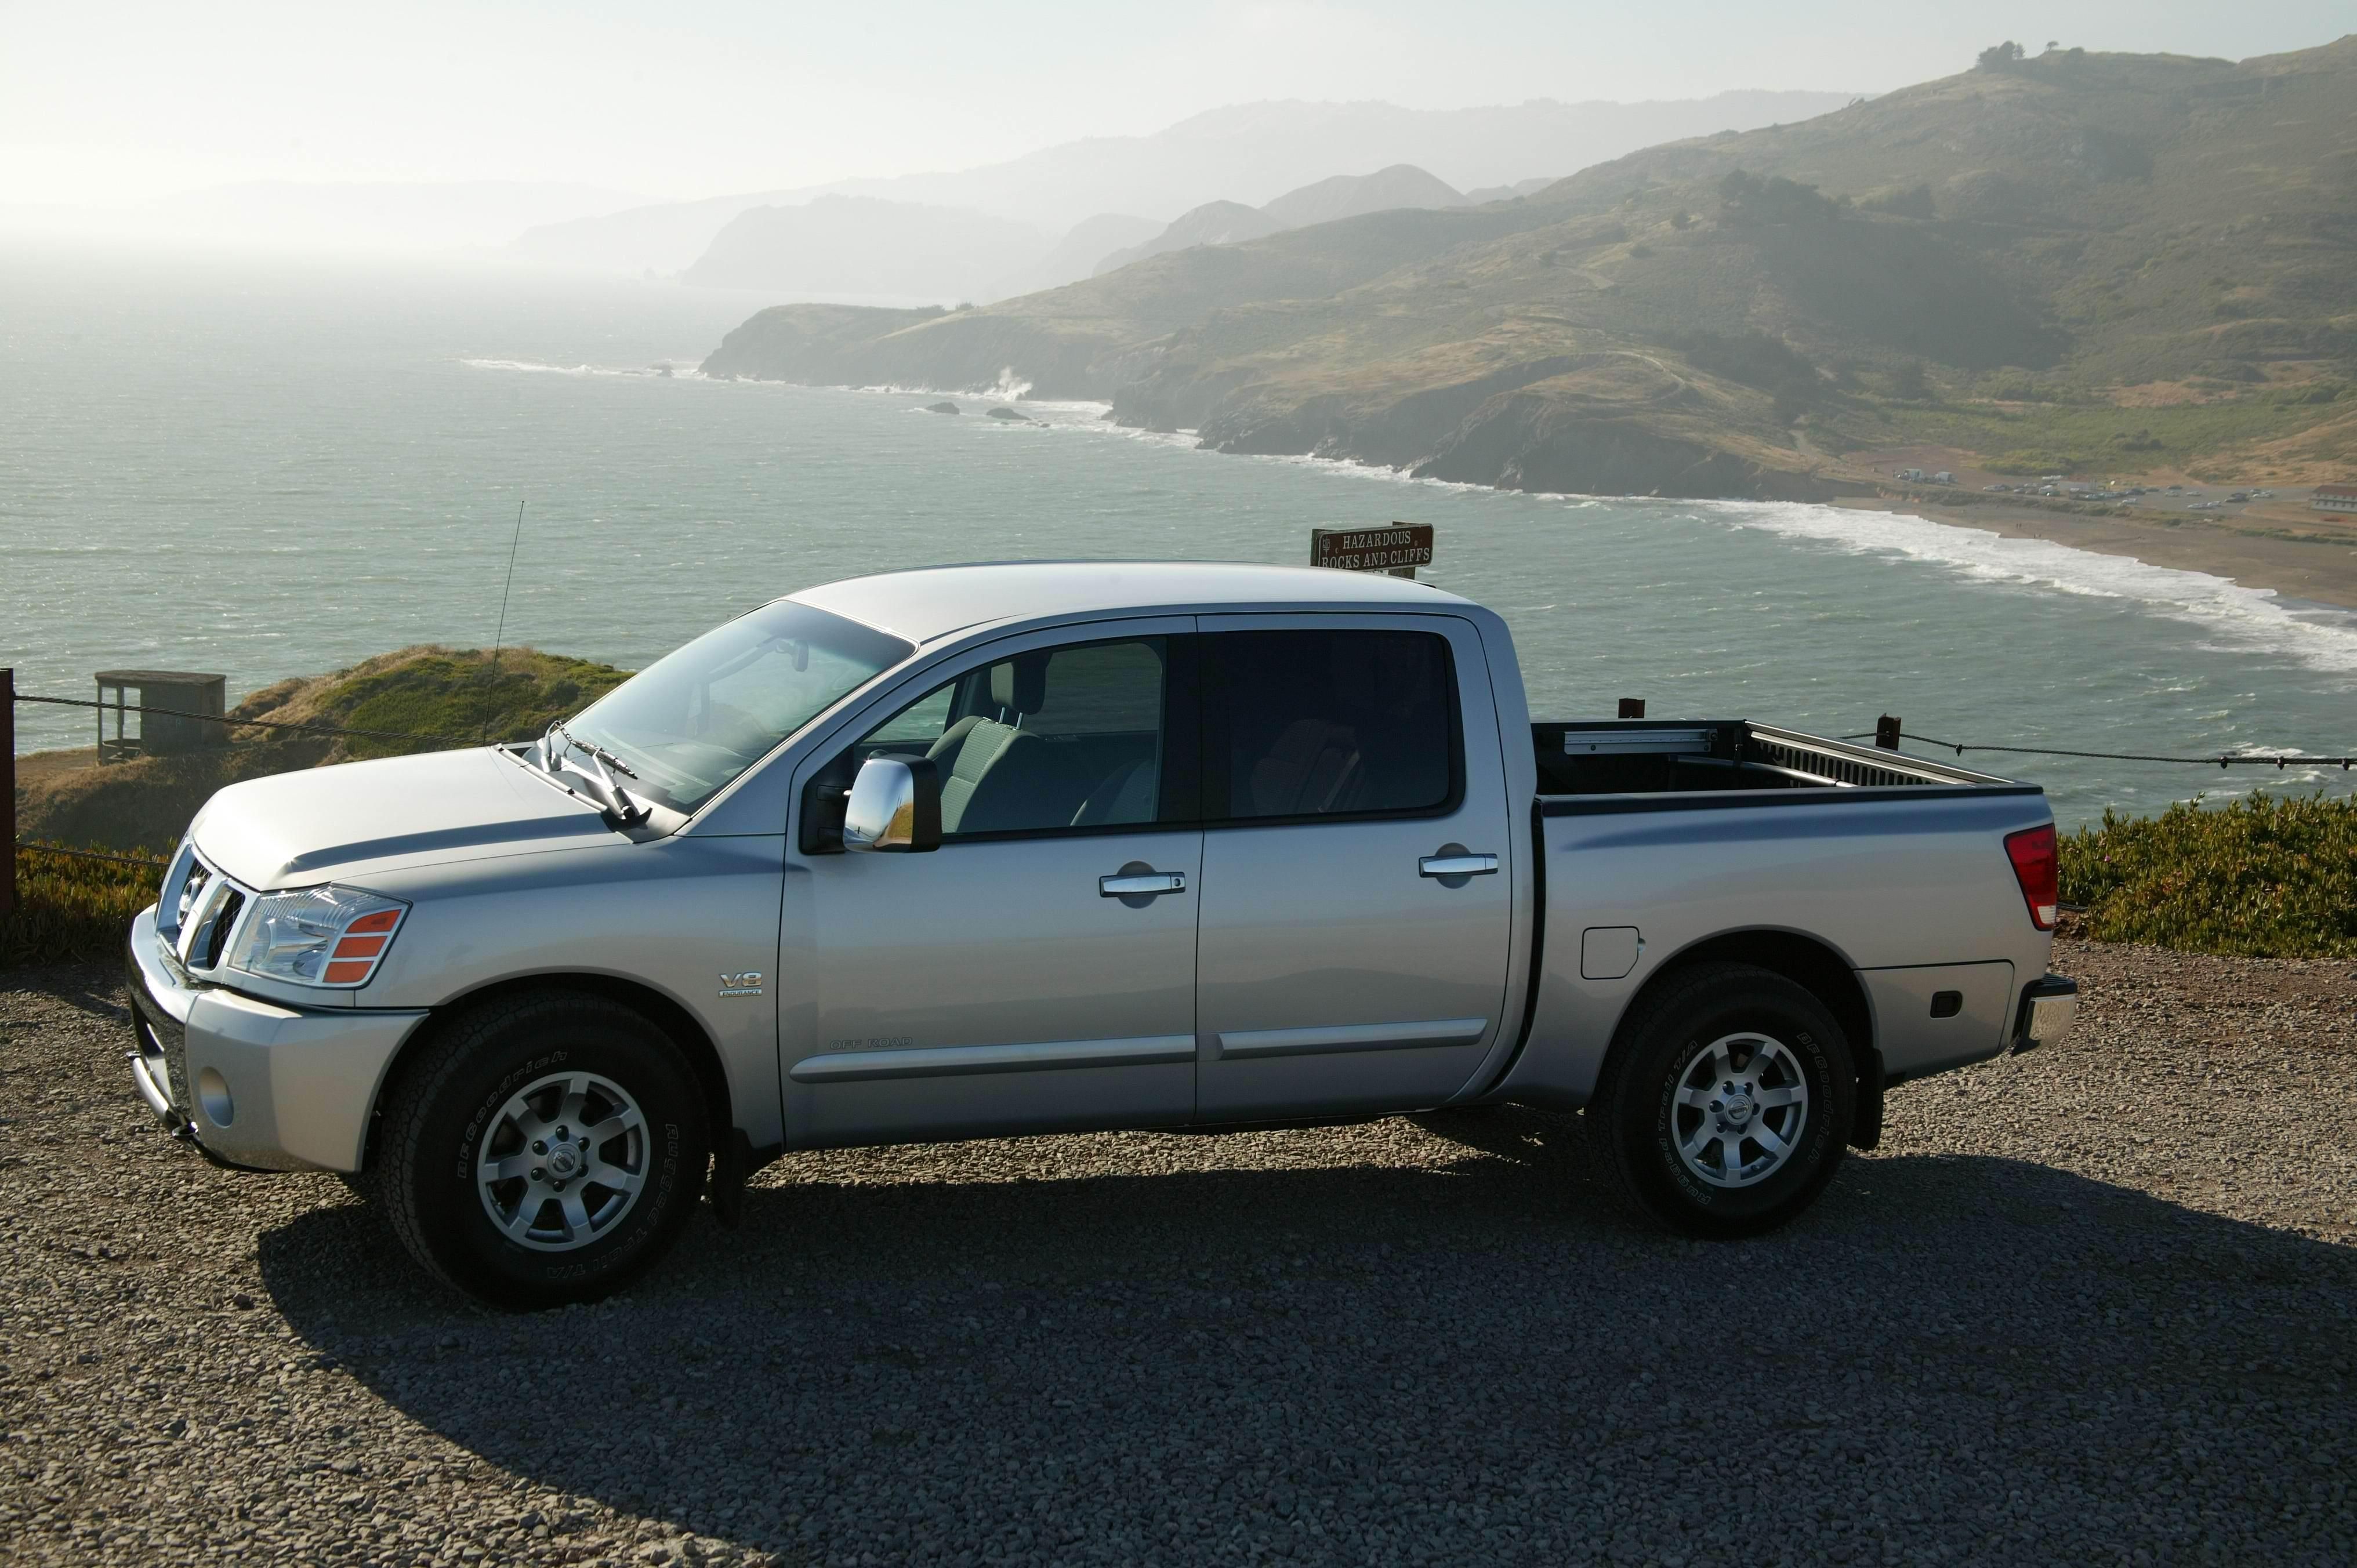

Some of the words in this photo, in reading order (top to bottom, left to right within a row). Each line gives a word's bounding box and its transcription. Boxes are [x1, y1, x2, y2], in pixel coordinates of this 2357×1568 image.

[1343, 531, 1411, 550] HAZARDOUS
[1322, 554, 1359, 569] ROCKS
[1364, 551, 1387, 567] AND
[1390, 547, 1430, 564] CLIFFS
[719, 972, 762, 988] V8
[829, 1039, 862, 1051] OFF
[868, 1036, 913, 1049] ROAD
[647, 1124, 679, 1226] Rugged
[1658, 1138, 1711, 1206] Rugged
